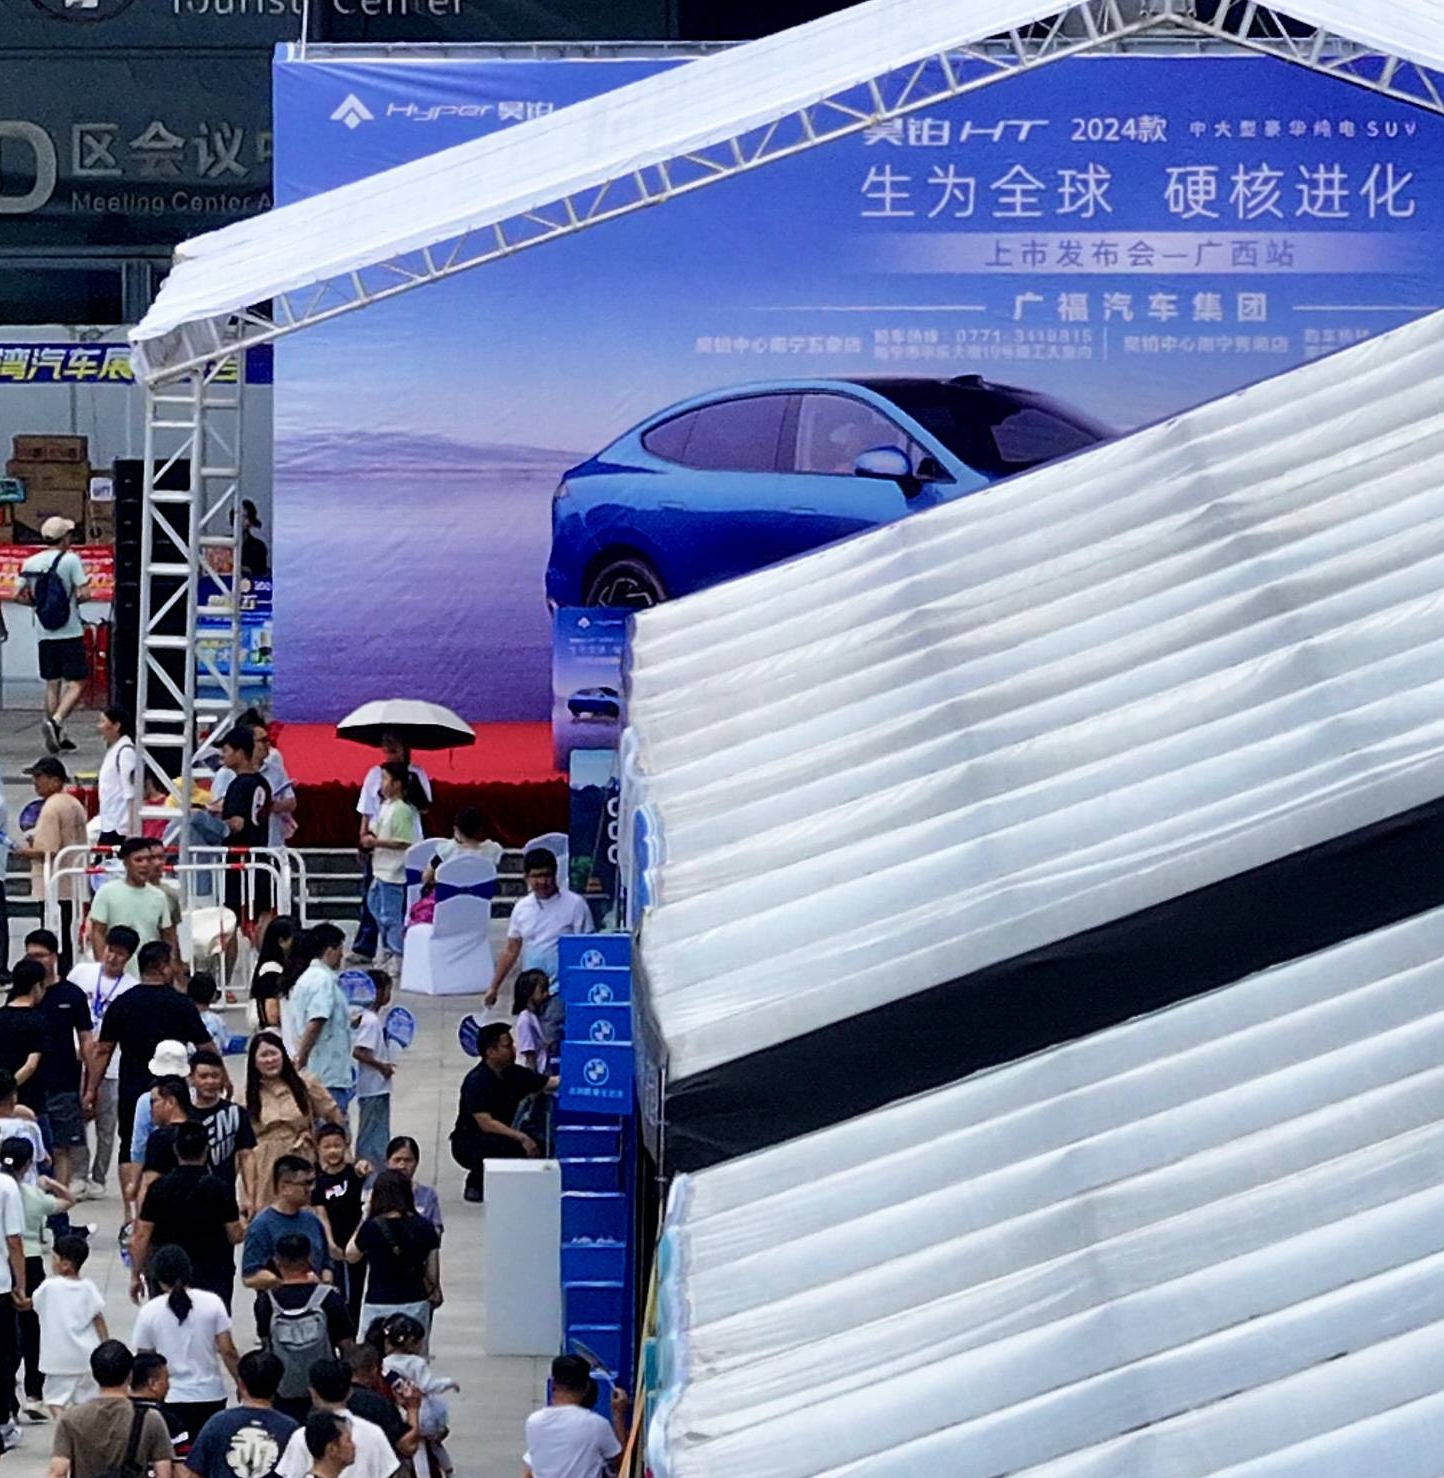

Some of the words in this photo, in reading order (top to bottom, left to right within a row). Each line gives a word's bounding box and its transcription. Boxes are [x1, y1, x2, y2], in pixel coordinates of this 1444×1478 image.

[385, 101, 493, 121] Hyper
[1070, 115, 1169, 144] 2024款
[859, 163, 1113, 220] 生为全球
[1163, 162, 1418, 220] 硬核进化
[1012, 292, 1269, 323] 广福汽车集团
